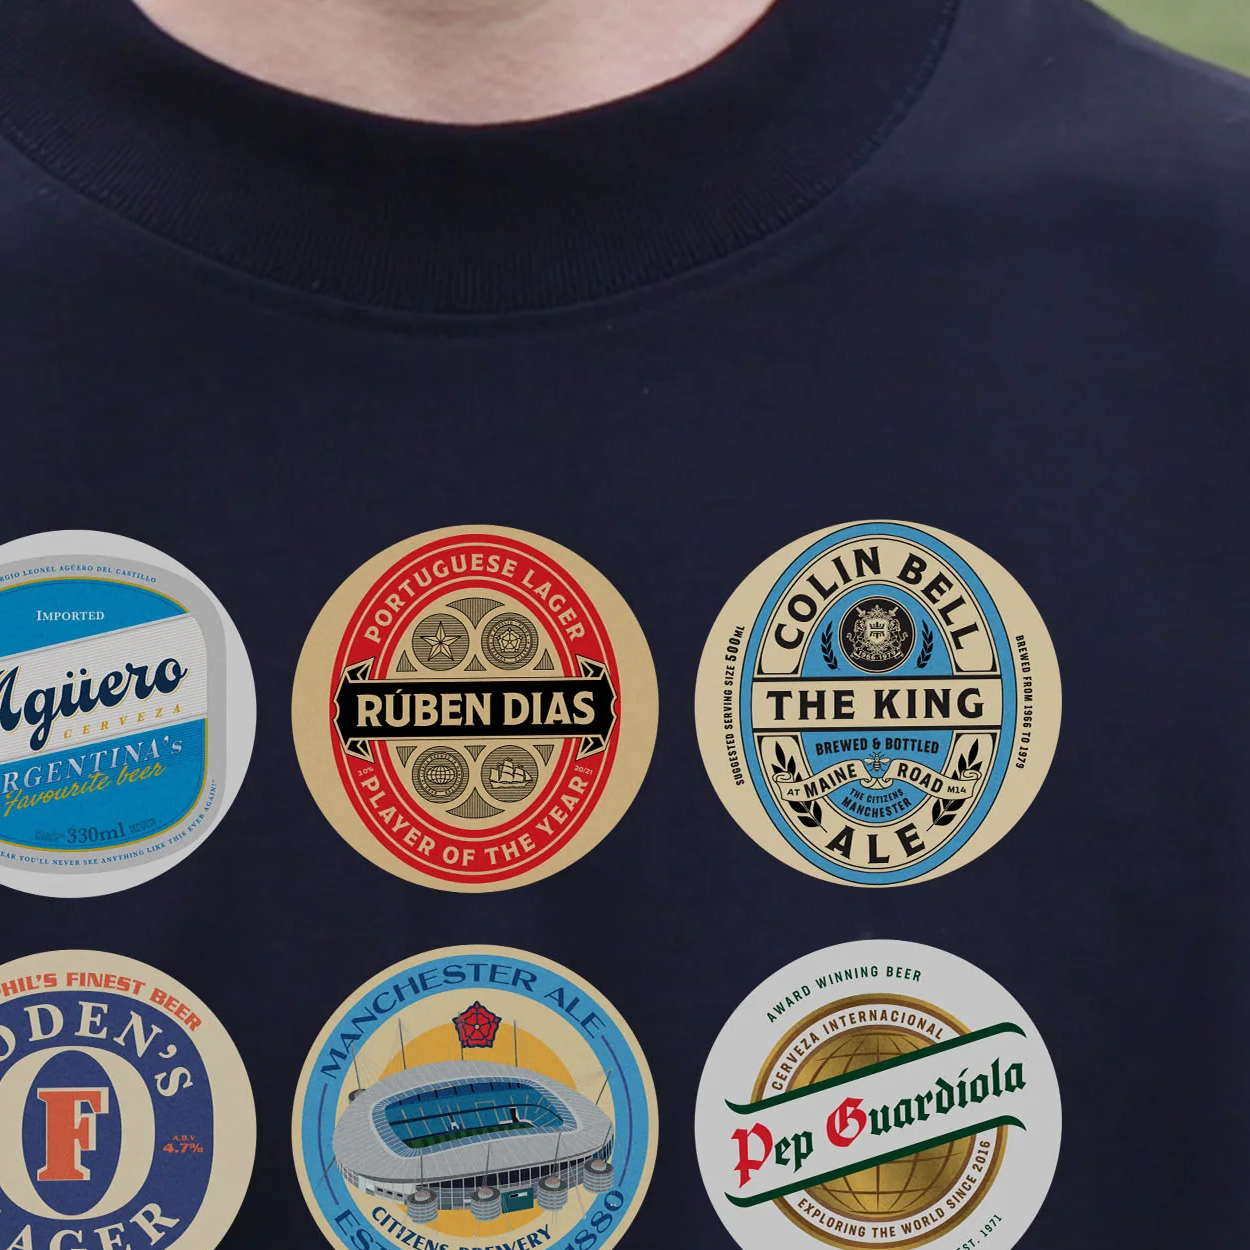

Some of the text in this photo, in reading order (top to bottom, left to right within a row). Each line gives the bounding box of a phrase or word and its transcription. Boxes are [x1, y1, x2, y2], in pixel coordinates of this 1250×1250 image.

[22, 566, 56, 577] LEONEL
[115, 568, 157, 583] CASTILLO
[364, 554, 517, 644] PORTUGUESE
[522, 568, 586, 642] LAGER
[774, 546, 980, 651] COLIN BELL
[64, 703, 181, 739] CERVEZA
[356, 688, 595, 727] RÚBEN DIAS
[724, 625, 745, 786] SUGGESTED SERVING SIZE 500ML
[766, 687, 984, 721] THE KING
[1016, 635, 1032, 769] BREWED FROM 1966 TO 1979
[574, 765, 593, 775] 20/21
[815, 737, 940, 756] BREWED & BOTTLED
[3, 762, 166, 817] favourite beer
[787, 788, 801, 796] AT
[804, 763, 858, 798] MAINE
[897, 763, 943, 794] ROAD
[850, 788, 904, 804] THE CITIZENS
[67, 822, 125, 844] 330ml
[360, 775, 589, 867] PLAYER OF THE YEAR
[841, 797, 912, 818] MANCHESTER
[19, 856, 49, 865] YOU'LL
[52, 858, 80, 866] NEVER
[101, 850, 145, 863] ANYTHING
[147, 842, 166, 853] LIKE
[167, 831, 186, 844] THIS
[187, 813, 205, 832] EVER
[826, 822, 926, 864] ALE
[66, 972, 147, 995] FINEST
[148, 987, 202, 1032] BEER
[321, 962, 607, 1079] MANCHESTER ALE
[766, 965, 922, 1023] AWARD WINNING BEER
[771, 1009, 943, 1091] CERVEZA INTERNACIONAL
[37, 1087, 109, 1181] F
[162, 1143, 204, 1153] 4.7%
[731, 1121, 814, 1189] Pep
[797, 1139, 991, 1238] EXPLORING THE WORLD SINCE 2016
[979, 1213, 1003, 1237] 1971
